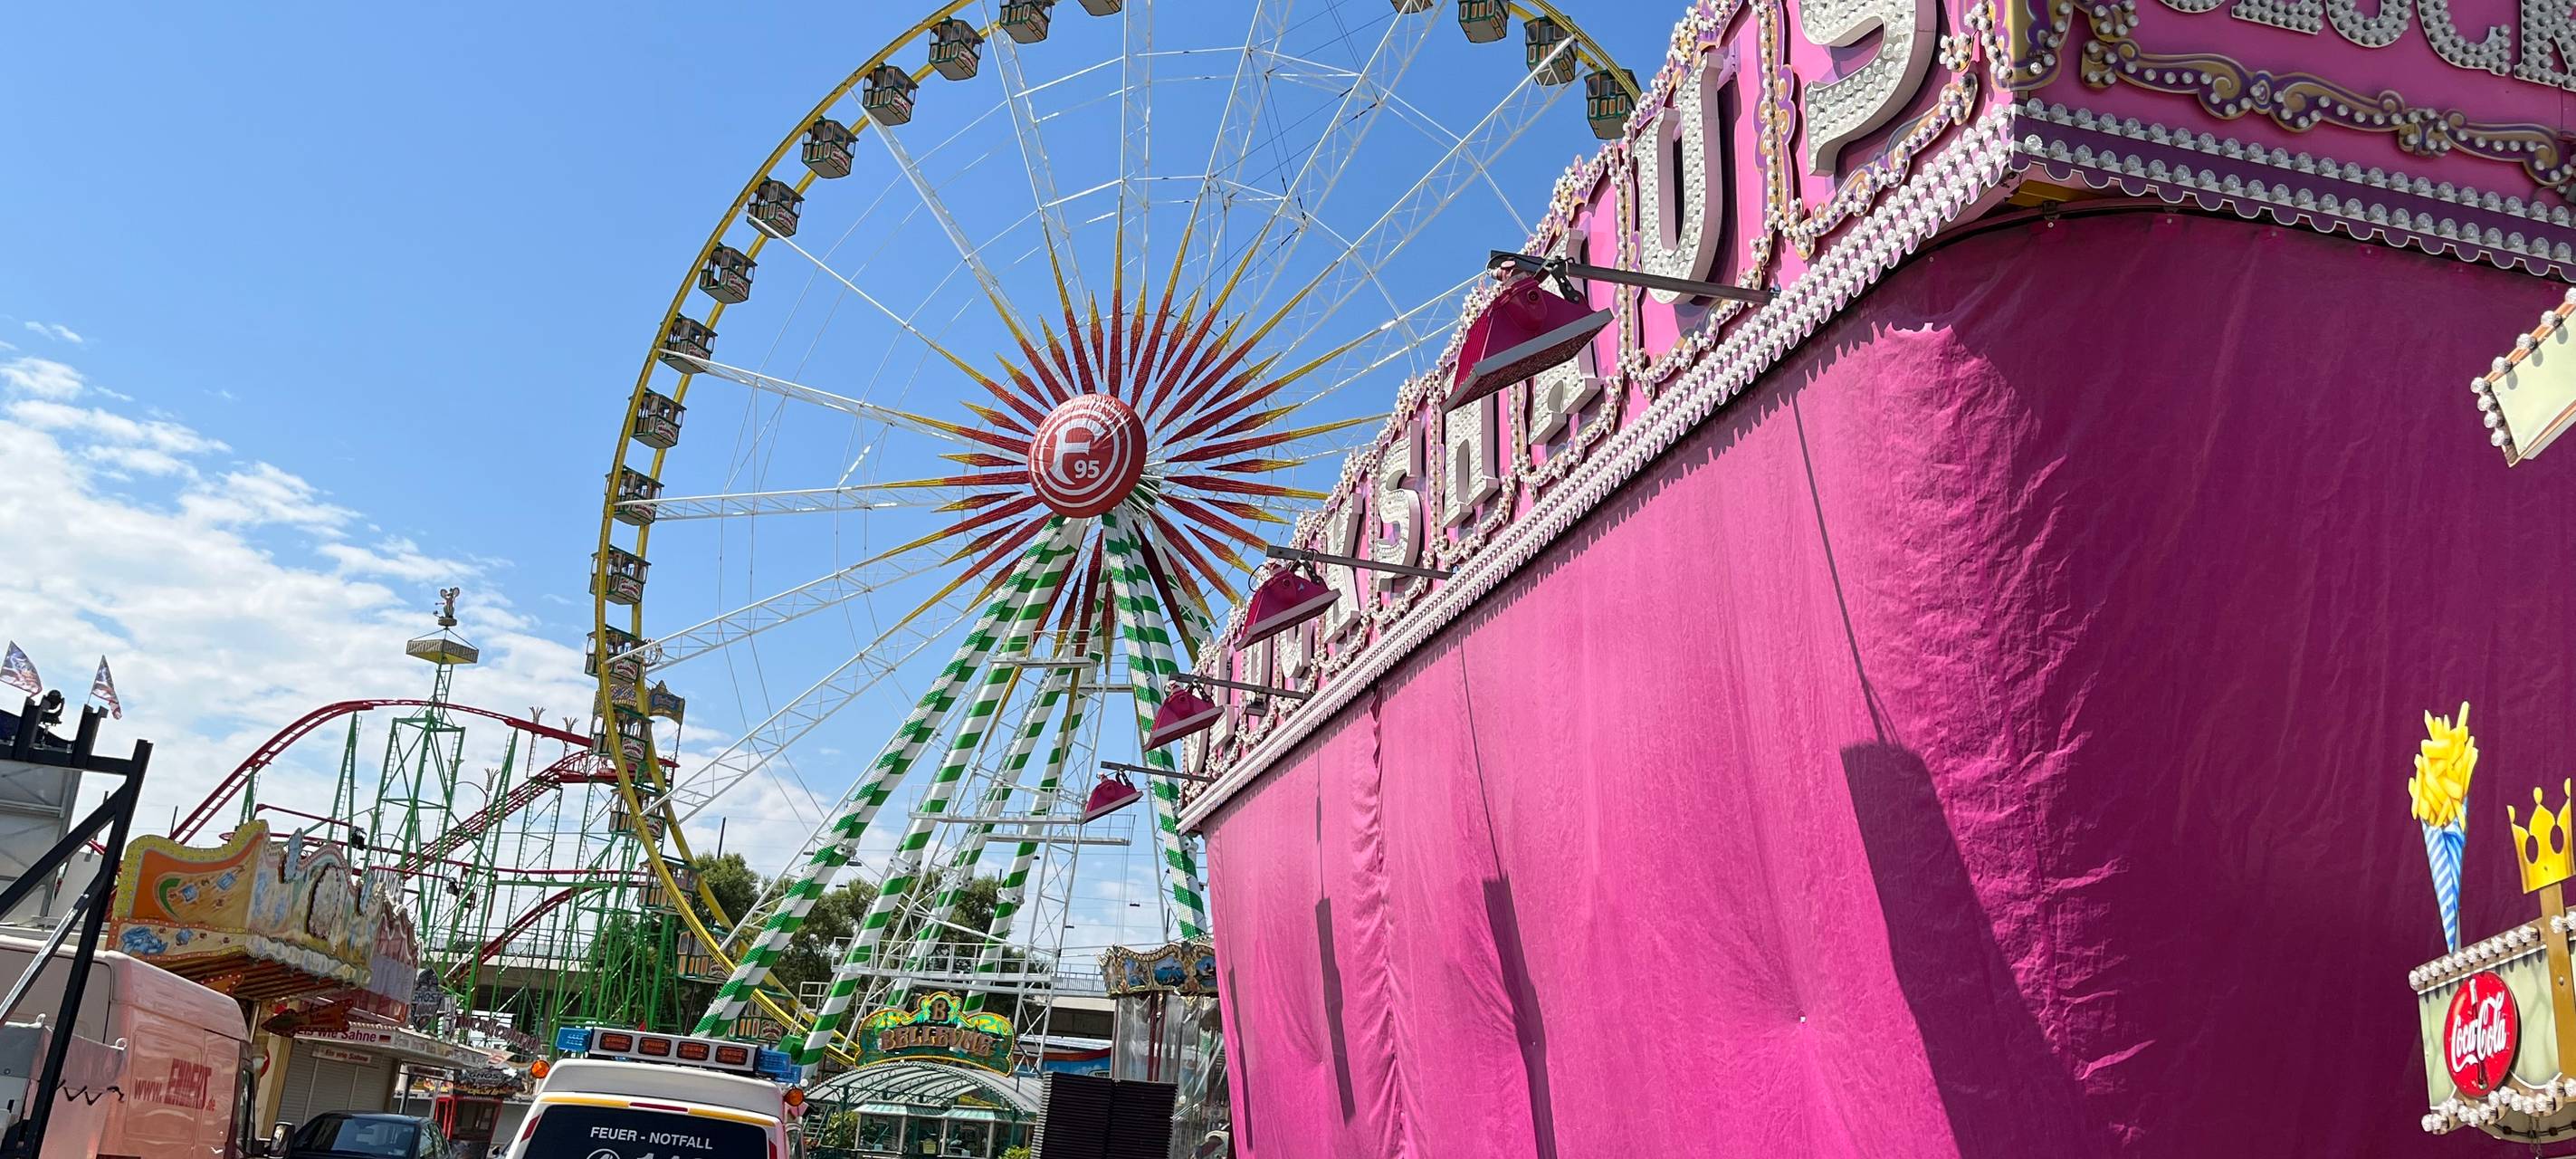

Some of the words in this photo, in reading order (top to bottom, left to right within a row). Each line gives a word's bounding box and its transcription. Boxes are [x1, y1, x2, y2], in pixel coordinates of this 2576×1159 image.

[1073, 459, 1101, 479] 95
[931, 999, 948, 1020] B
[341, 1030, 376, 1042] Sahne
[879, 1026, 995, 1057] BELLEVUE
[2450, 991, 2507, 1073] Coca-Cola
[589, 1126, 637, 1142] FEUER
[648, 1132, 714, 1150] NOTFALL
